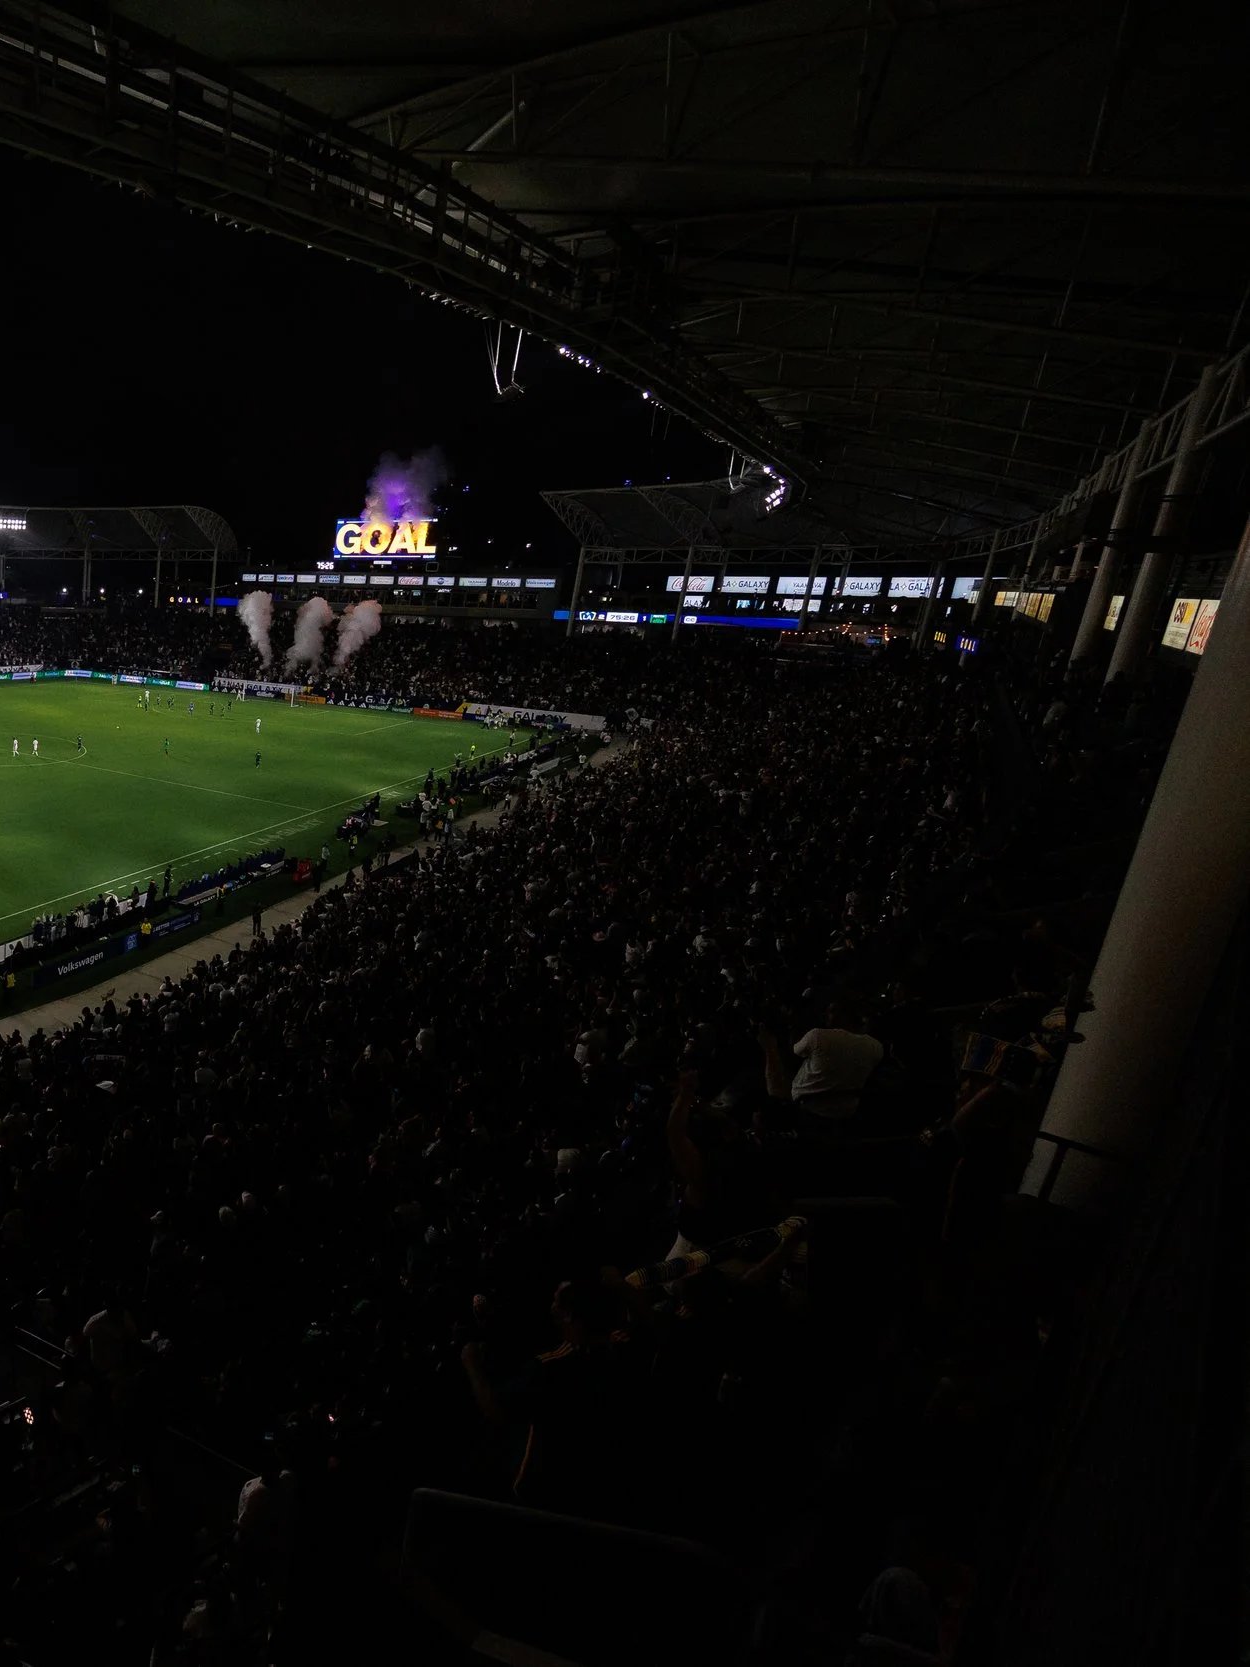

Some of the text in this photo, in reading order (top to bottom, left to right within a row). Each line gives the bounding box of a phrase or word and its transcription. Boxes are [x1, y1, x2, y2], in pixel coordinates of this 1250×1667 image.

[335, 522, 437, 555] GOAL
[496, 580, 516, 588] Modelo
[57, 952, 104, 976] Volkswagen
